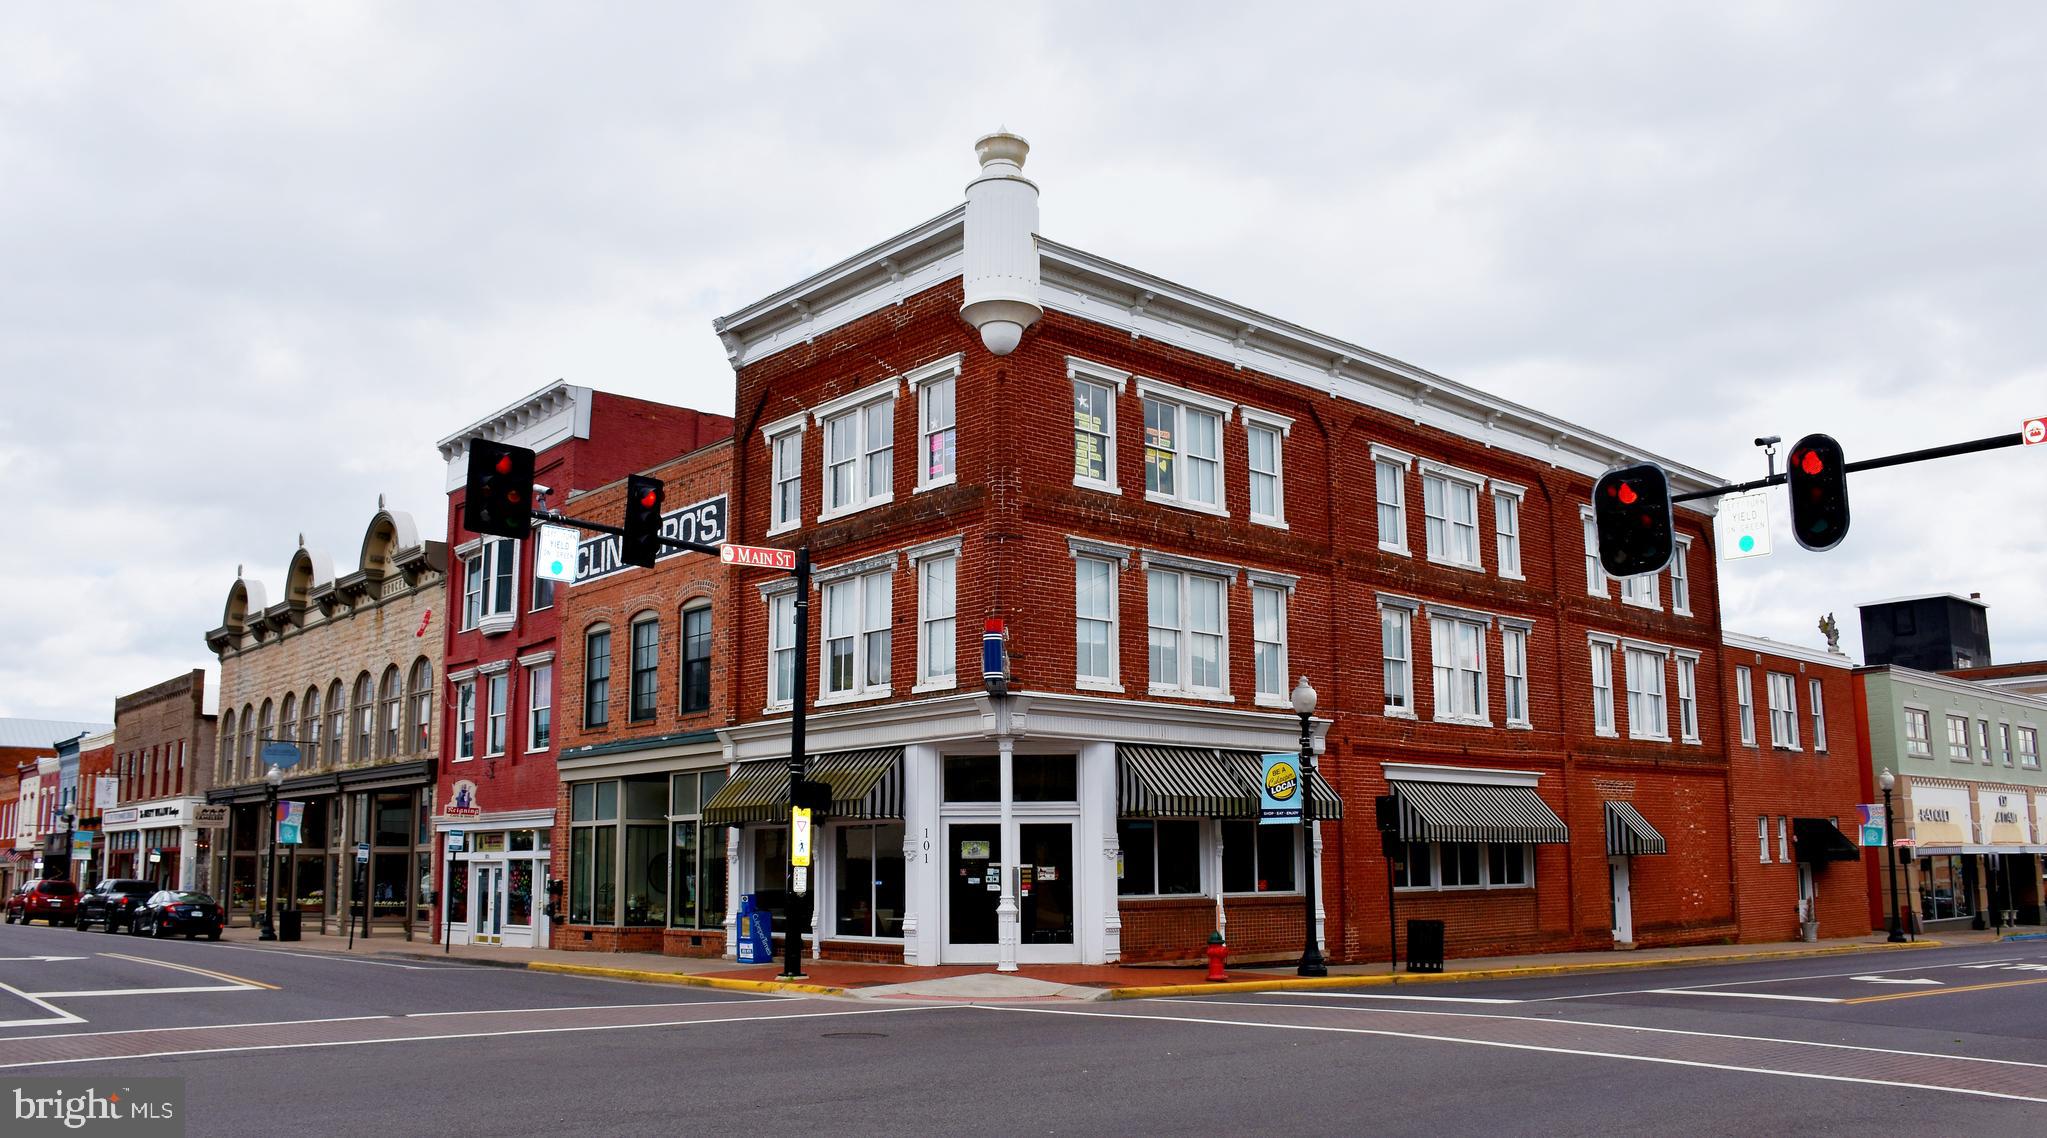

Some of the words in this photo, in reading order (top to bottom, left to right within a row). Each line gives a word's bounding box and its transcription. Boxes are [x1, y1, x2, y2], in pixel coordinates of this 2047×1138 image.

[1732, 510, 1757, 521] YIELD
[550, 540, 570, 551] YIELD
[575, 534, 627, 580] CLIN
[1272, 769, 1281, 777] BE
[1271, 780, 1296, 794] LOCAL
